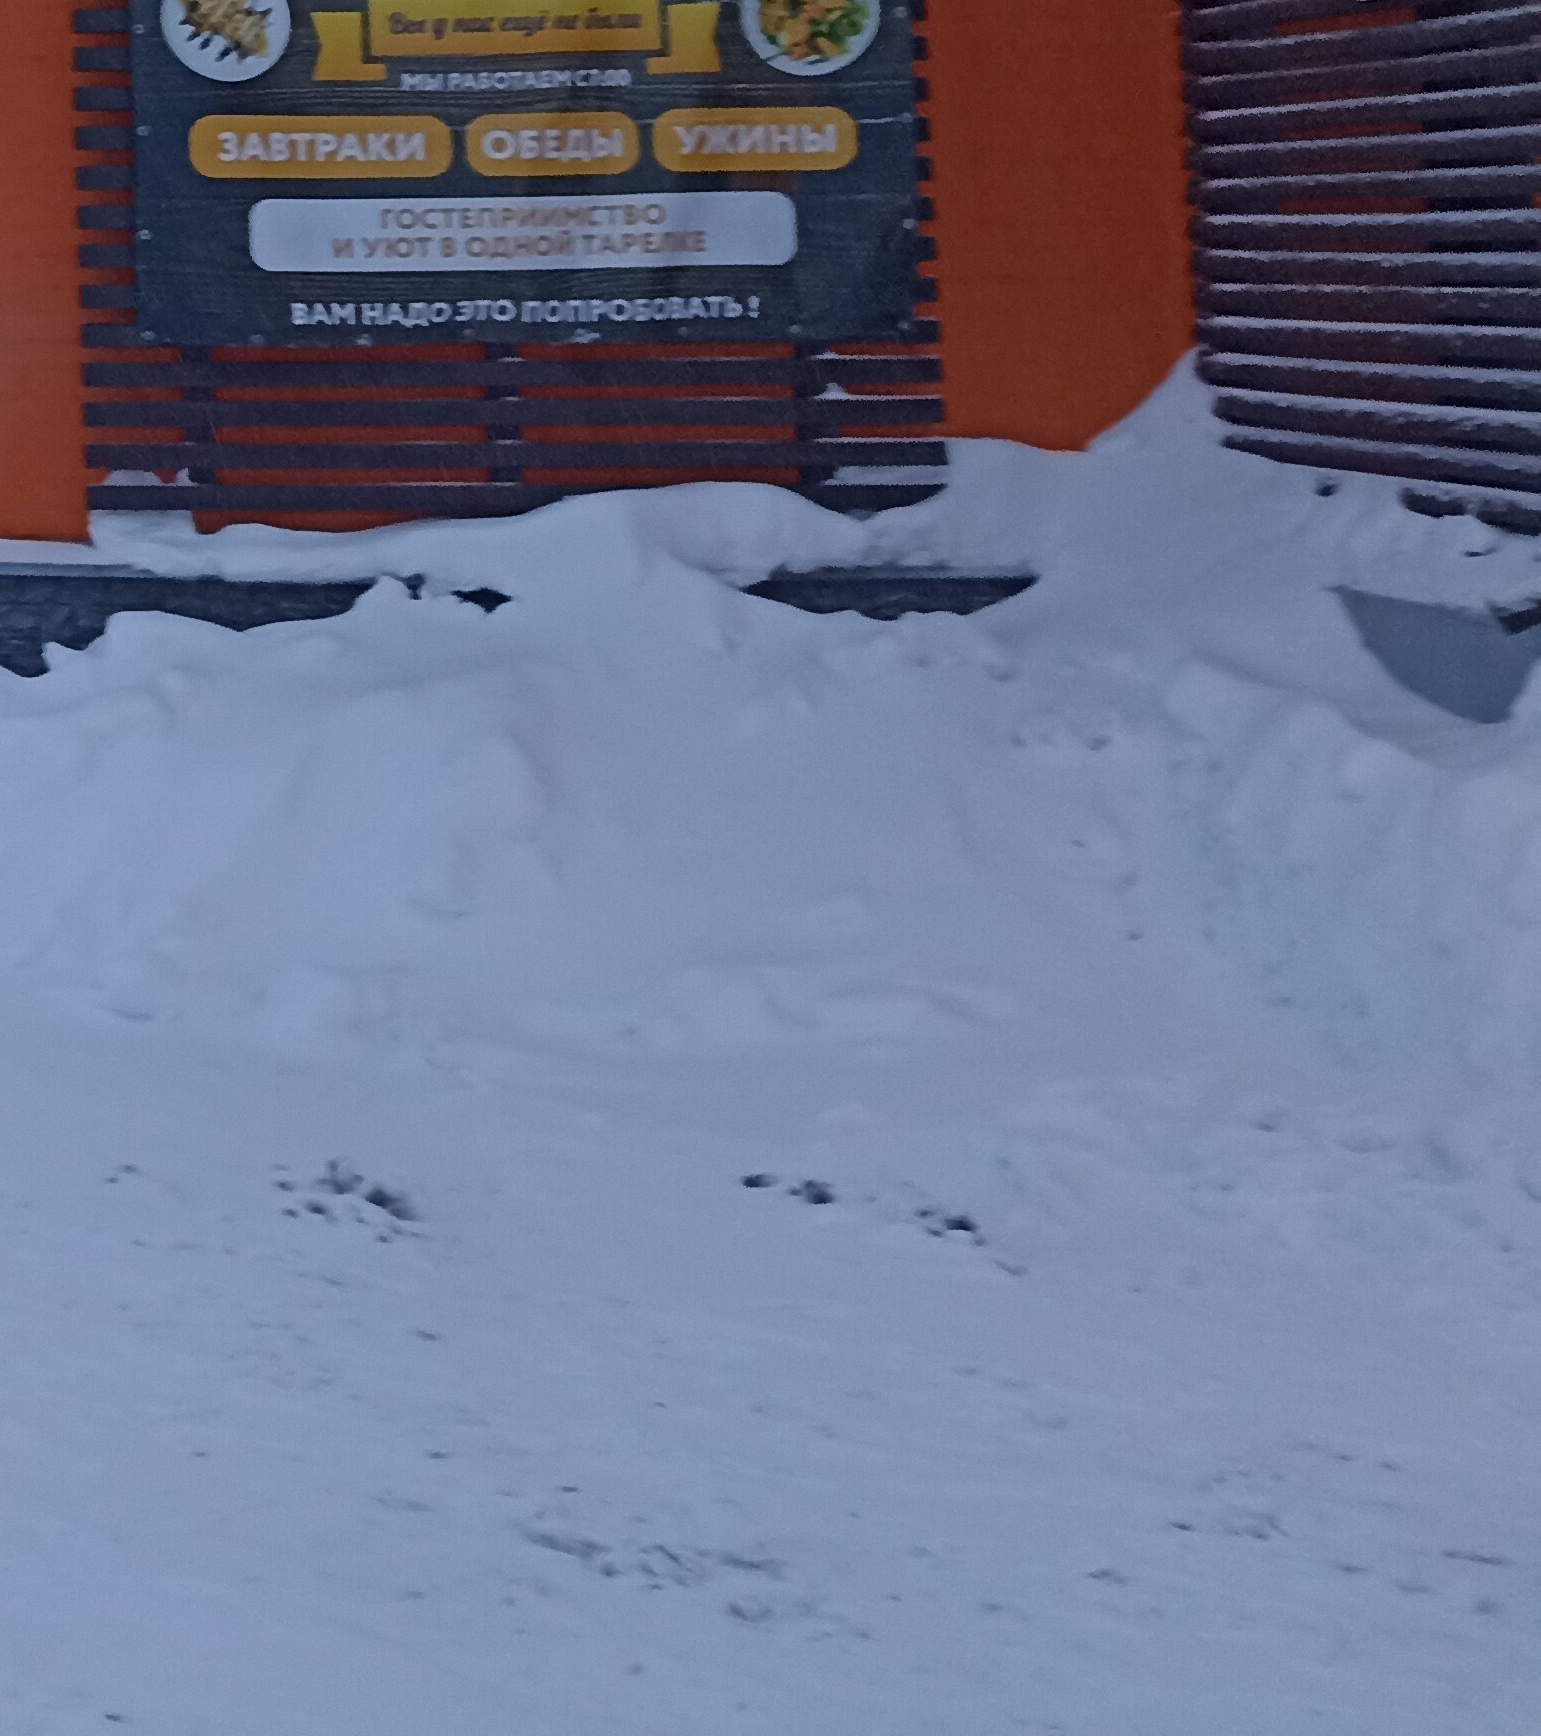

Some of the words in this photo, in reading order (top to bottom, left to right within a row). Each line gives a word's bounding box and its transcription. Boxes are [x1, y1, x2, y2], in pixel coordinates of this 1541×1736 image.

[217, 131, 426, 162] ЗАВТРАКИ
[480, 129, 625, 162] ОБЕДЫ
[674, 124, 838, 155] УЖИНЫ
[379, 204, 667, 230] ГОСТЕПРИИМСТВО
[332, 238, 354, 258] И
[360, 237, 431, 258] УЮТ
[440, 237, 457, 257] В
[464, 230, 574, 260] ОДНОЙ
[580, 230, 707, 255] ТАРЕЛКЕ
[290, 303, 357, 326] ВАМ
[360, 302, 452, 328] НАДО
[454, 299, 517, 322] ЭТО
